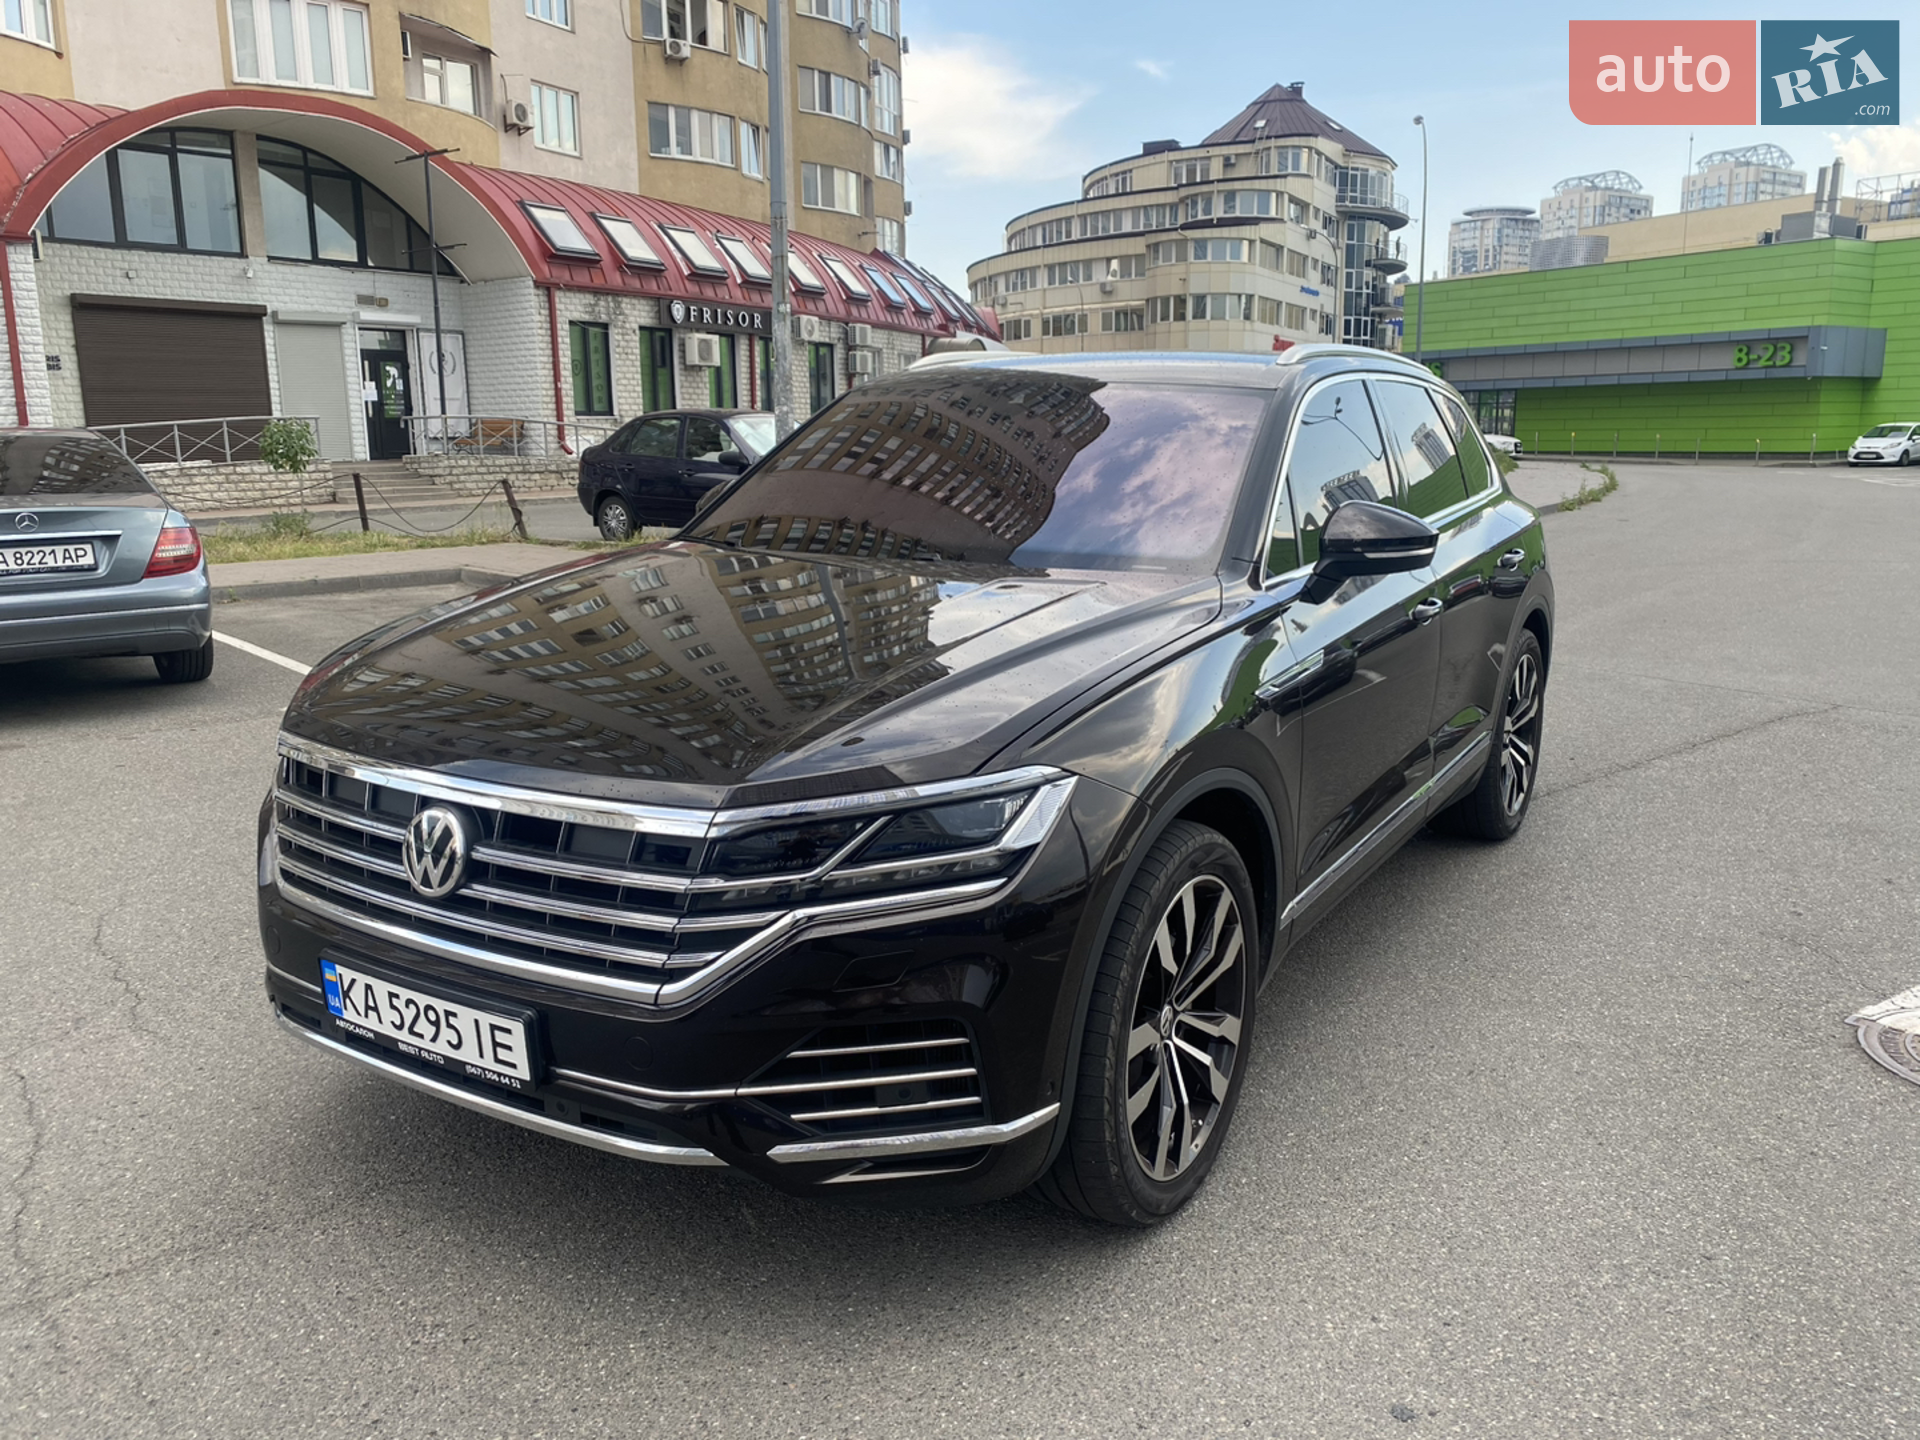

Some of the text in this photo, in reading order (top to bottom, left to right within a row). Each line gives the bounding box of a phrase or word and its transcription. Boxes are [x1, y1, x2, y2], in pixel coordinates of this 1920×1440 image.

[688, 305, 763, 329] FRISOR
[1732, 342, 1793, 368] 8-23
[13, 549, 58, 567] 8221
[61, 547, 88, 560] AP
[327, 994, 341, 1009] UA
[338, 972, 518, 1070] KA 5295 IE
[397, 1041, 445, 1065] BEST AUTO
